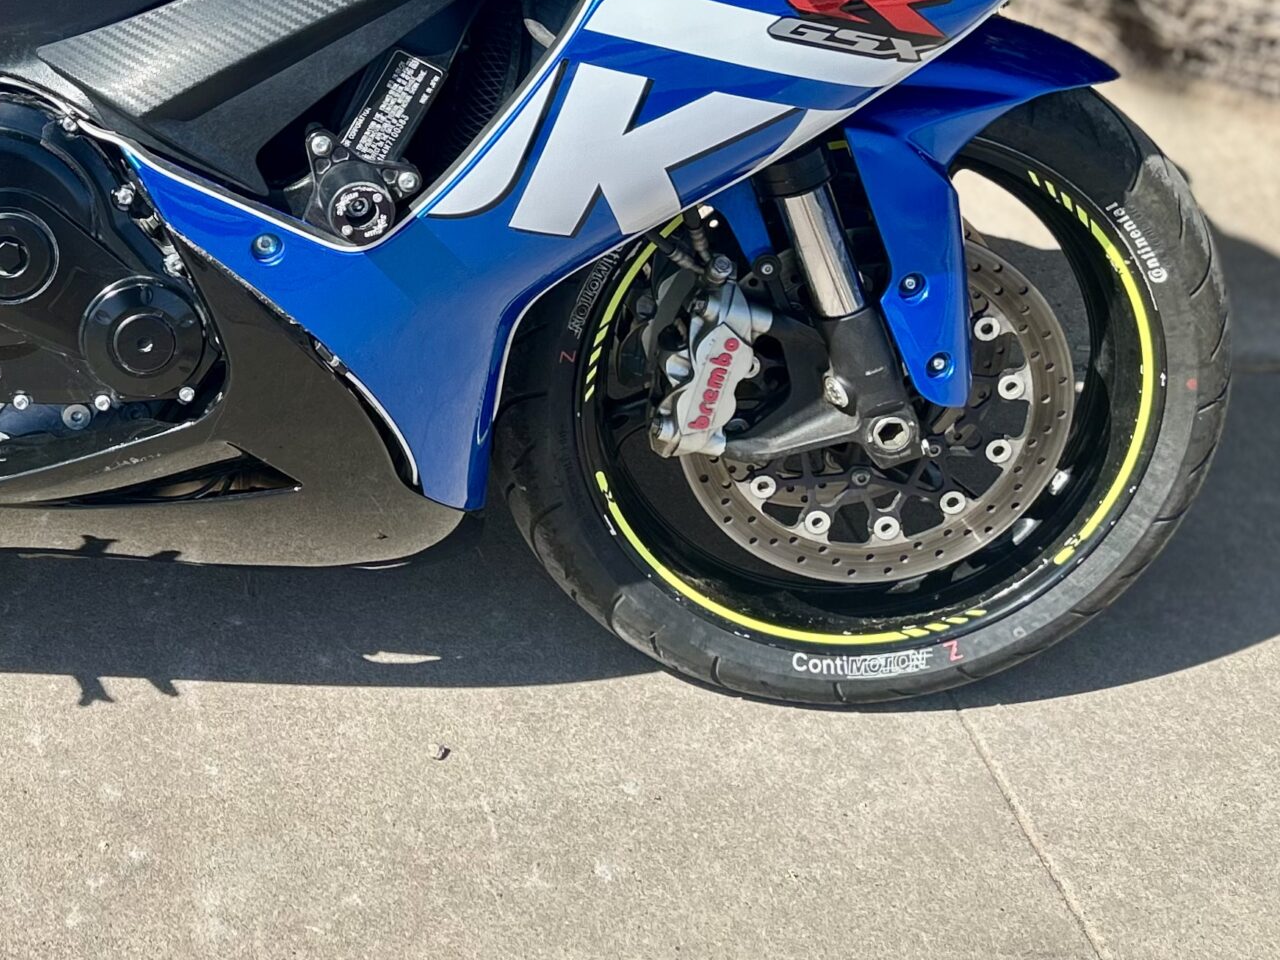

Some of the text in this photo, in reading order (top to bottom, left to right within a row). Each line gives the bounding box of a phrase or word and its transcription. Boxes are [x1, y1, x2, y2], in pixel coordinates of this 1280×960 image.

[768, 17, 942, 62] GSX
[1105, 201, 1169, 283] Continental
[687, 337, 740, 431] brembo
[792, 647, 934, 680] ContiMOTION
[942, 640, 965, 662] Z
